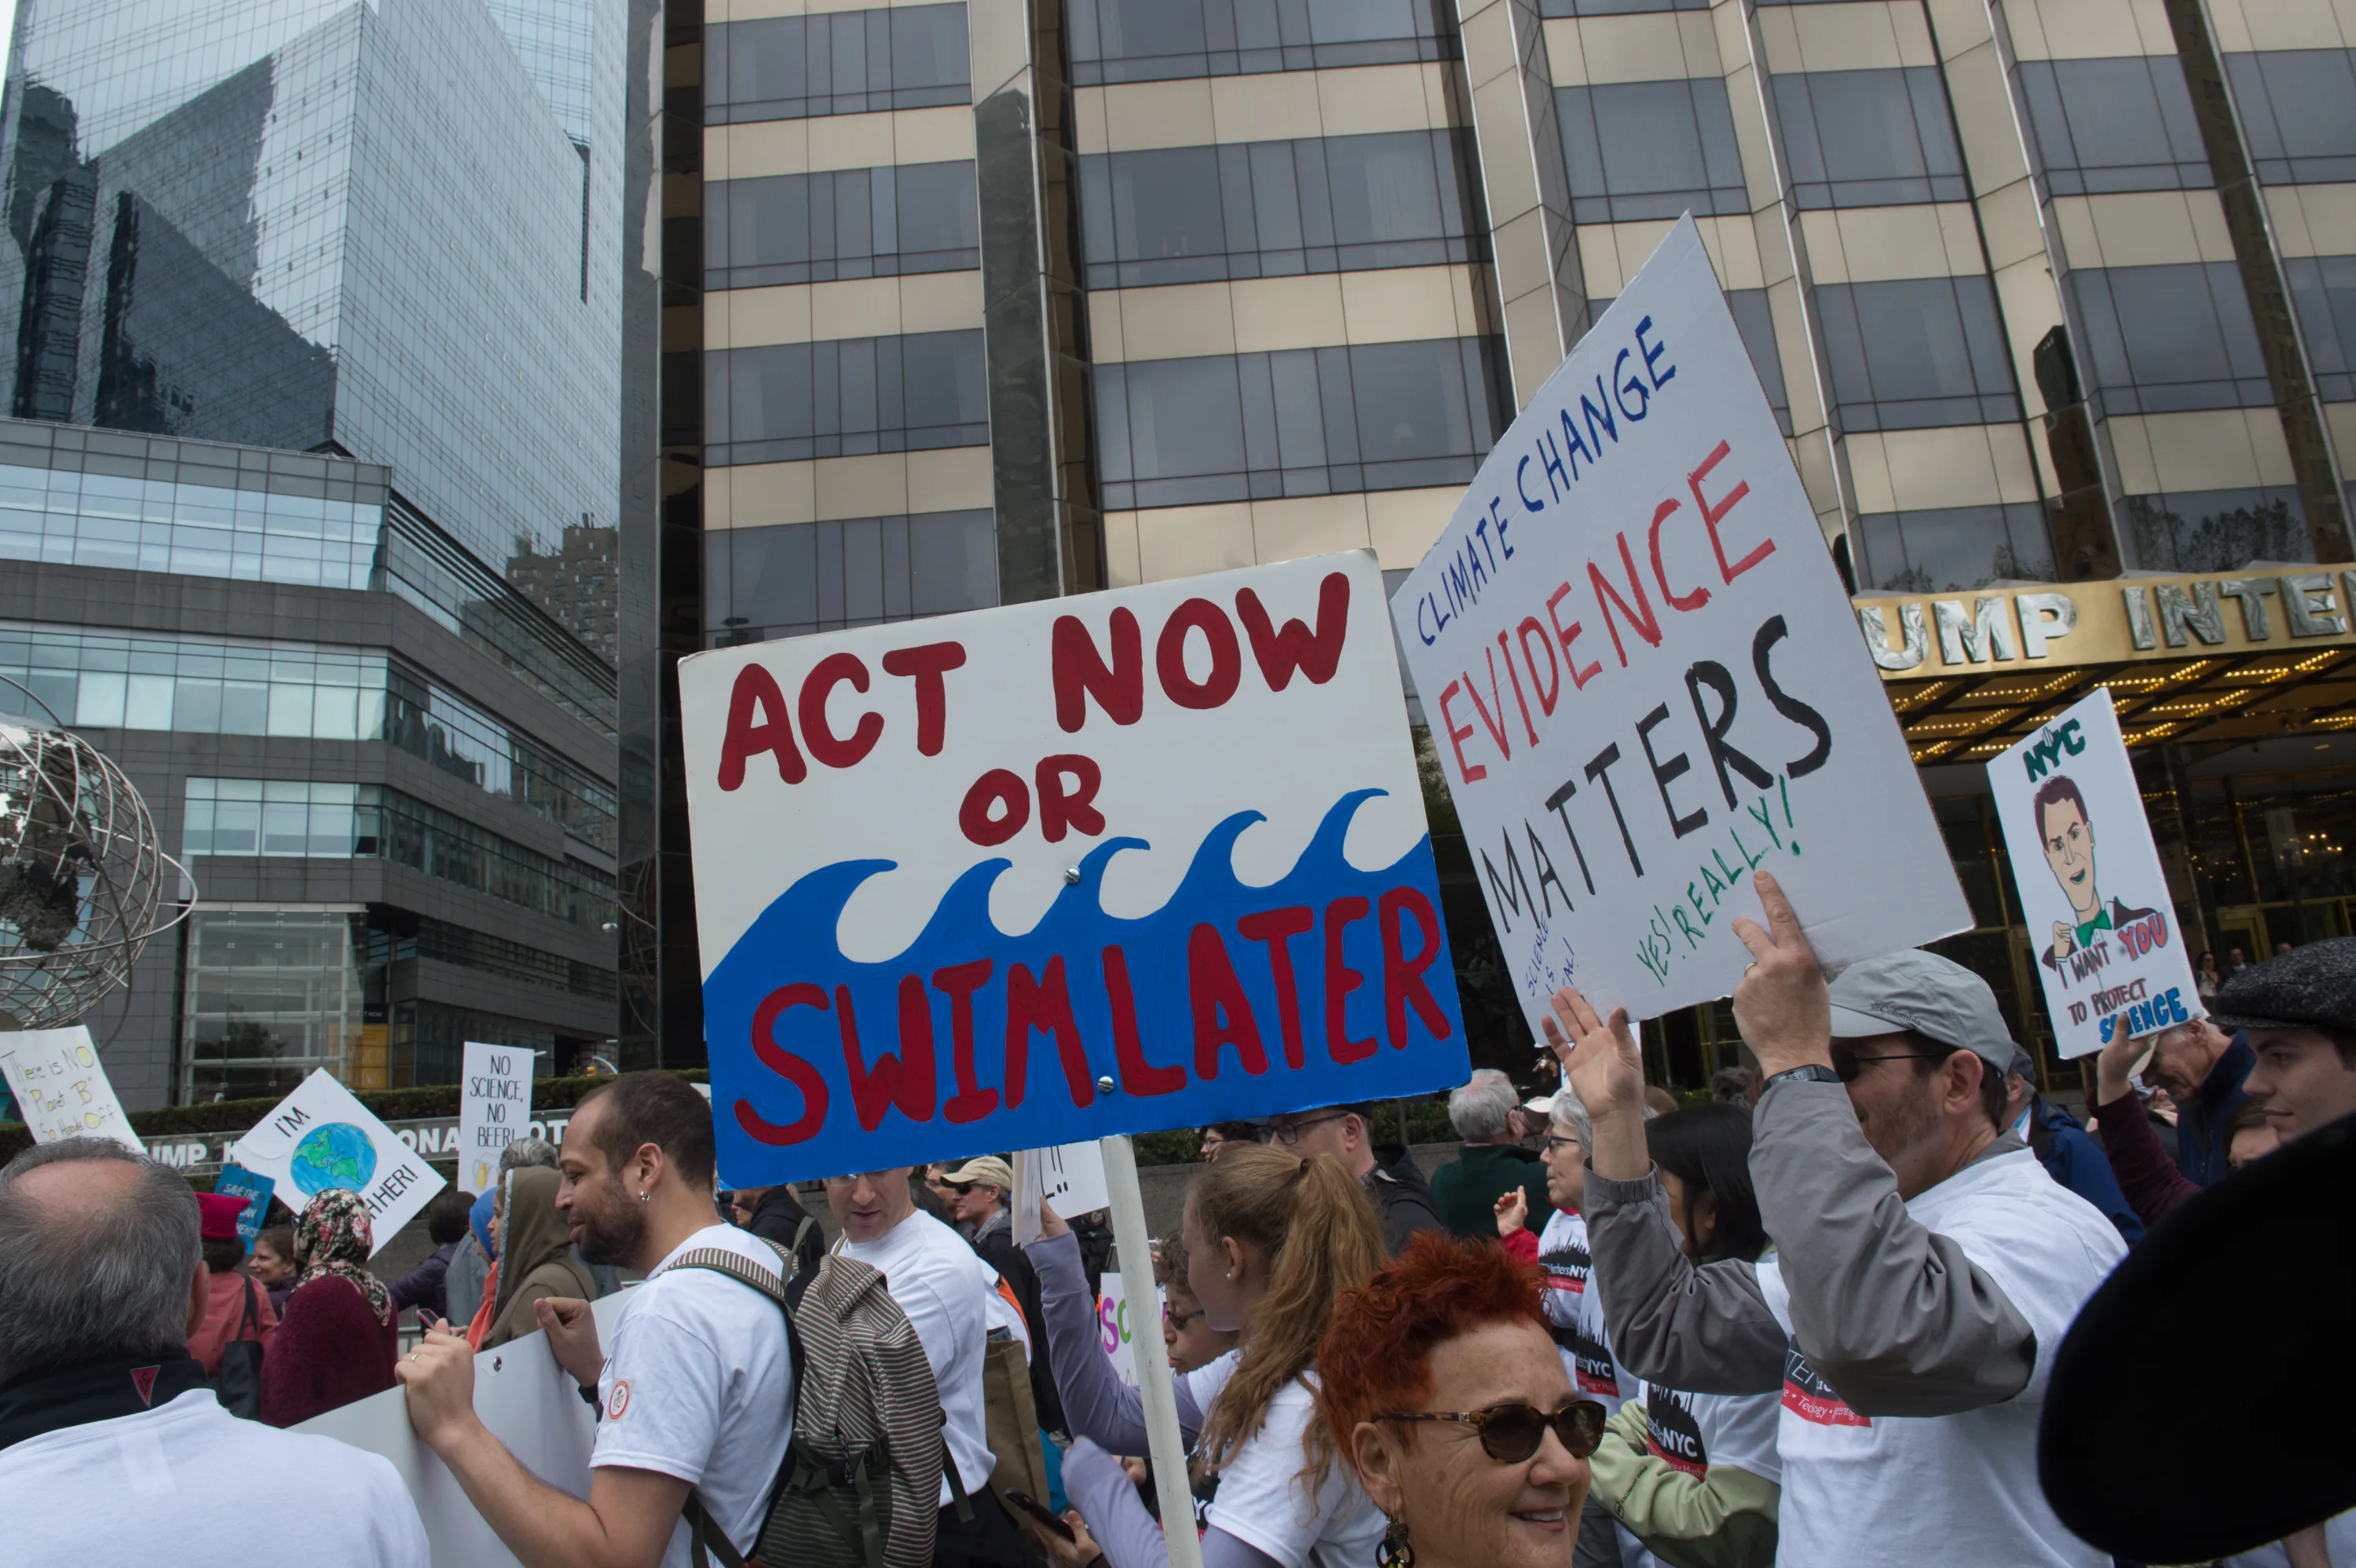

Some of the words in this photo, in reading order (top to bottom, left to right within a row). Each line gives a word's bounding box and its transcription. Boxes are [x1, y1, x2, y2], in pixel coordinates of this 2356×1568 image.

[1418, 497, 1513, 645] CLIMATE
[1517, 316, 1676, 513] CHANGE
[1440, 440, 1776, 784] EVIDENCE
[2123, 570, 2356, 651] INTE
[718, 641, 966, 791] ACT
[1052, 572, 1349, 733] NOW
[1480, 614, 1831, 934] MATTERS
[2022, 718, 2086, 783] NYC
[960, 754, 1105, 846] OR
[1673, 774, 1802, 950] REALLY!
[1526, 911, 1549, 997] SCIENCE
[2058, 963, 2068, 990] I
[2069, 941, 2111, 983] WANT
[2117, 912, 2168, 961] YOU
[734, 953, 1094, 1145] SWIM
[1102, 886, 1451, 1096] LATER
[2067, 1000, 2087, 1026] TO
[2091, 978, 2146, 1017] PROTECT
[46, 1060, 64, 1076] is
[62, 1046, 94, 1071] NO
[470, 1076, 524, 1102] SCIENCE,
[490, 1054, 511, 1076] NO
[275, 1106, 311, 1138] I'M
[487, 1103, 506, 1123] NO
[223, 1183, 244, 1197] SAVE
[243, 1189, 261, 1201] THE
